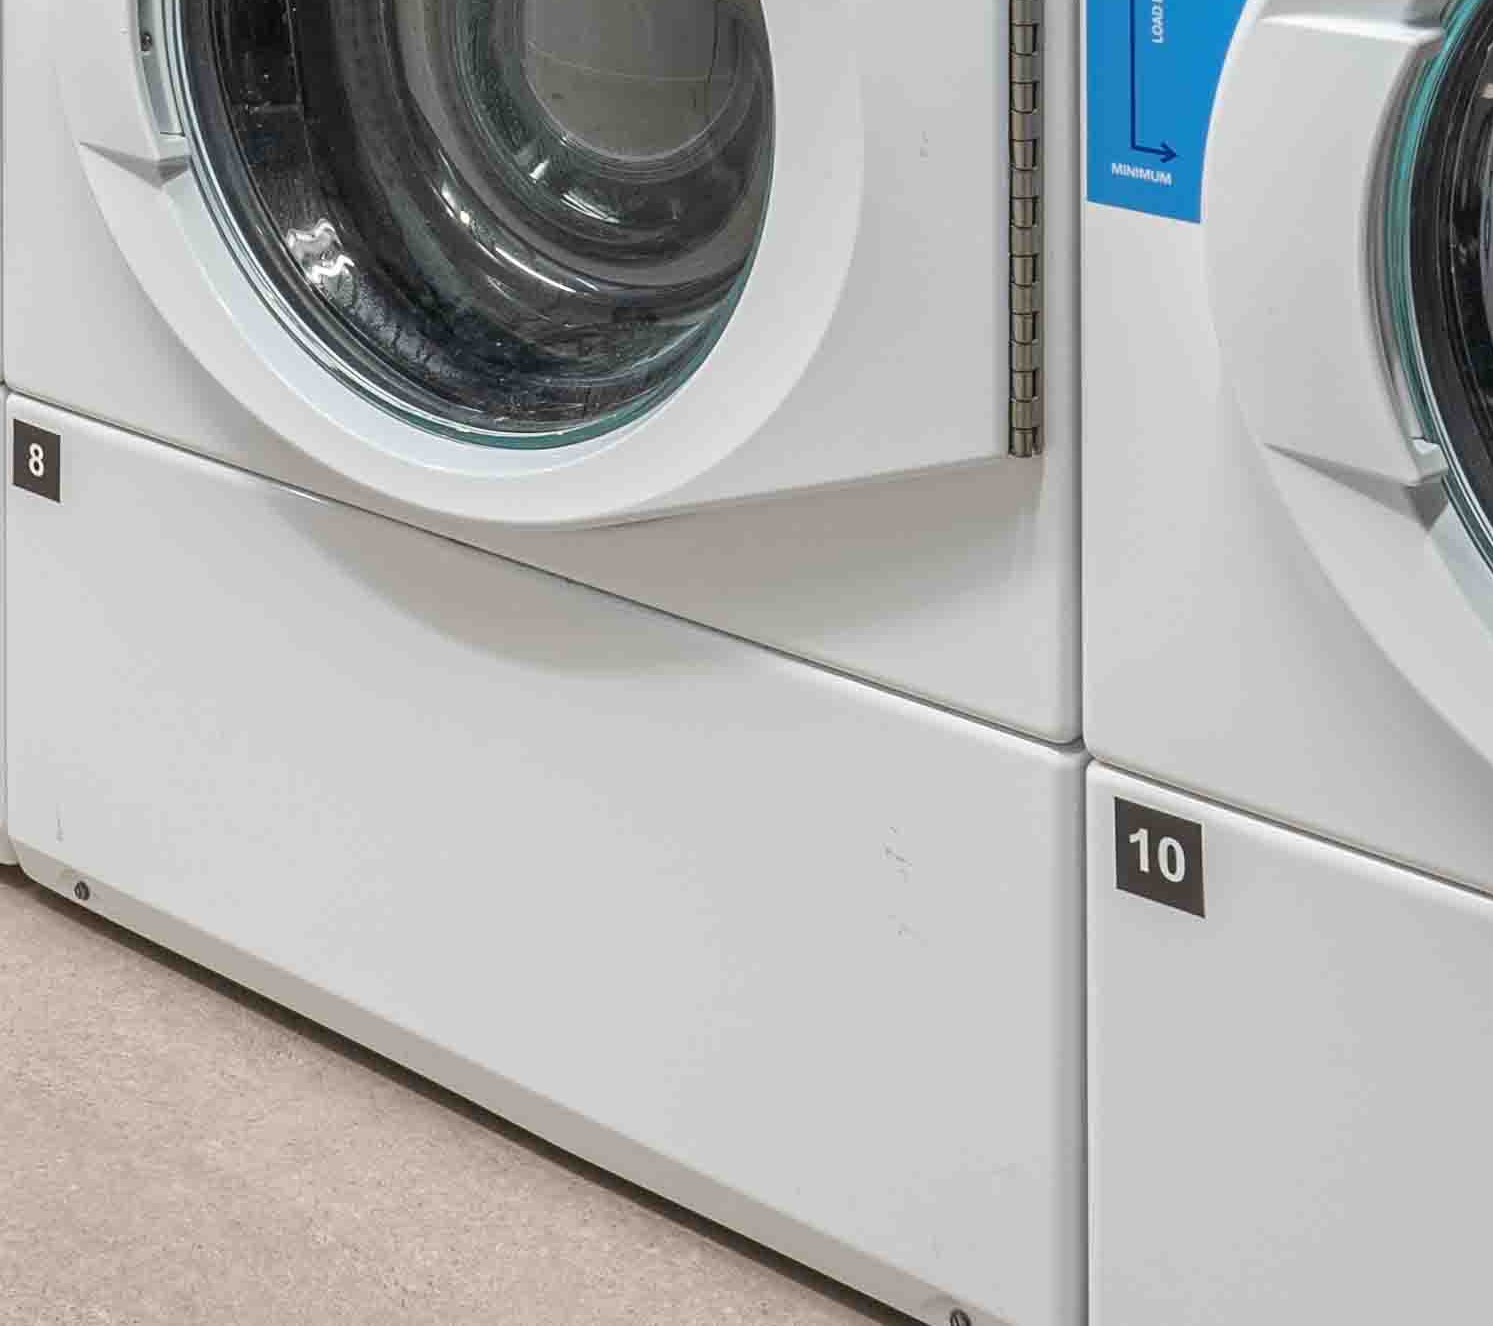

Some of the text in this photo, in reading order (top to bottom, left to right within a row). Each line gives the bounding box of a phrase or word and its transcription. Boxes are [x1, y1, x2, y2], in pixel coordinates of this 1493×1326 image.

[1152, 2, 1165, 44] LOAD
[1111, 162, 1172, 185] MINIMUM
[29, 443, 44, 477] 8
[1129, 828, 1185, 882] 10
